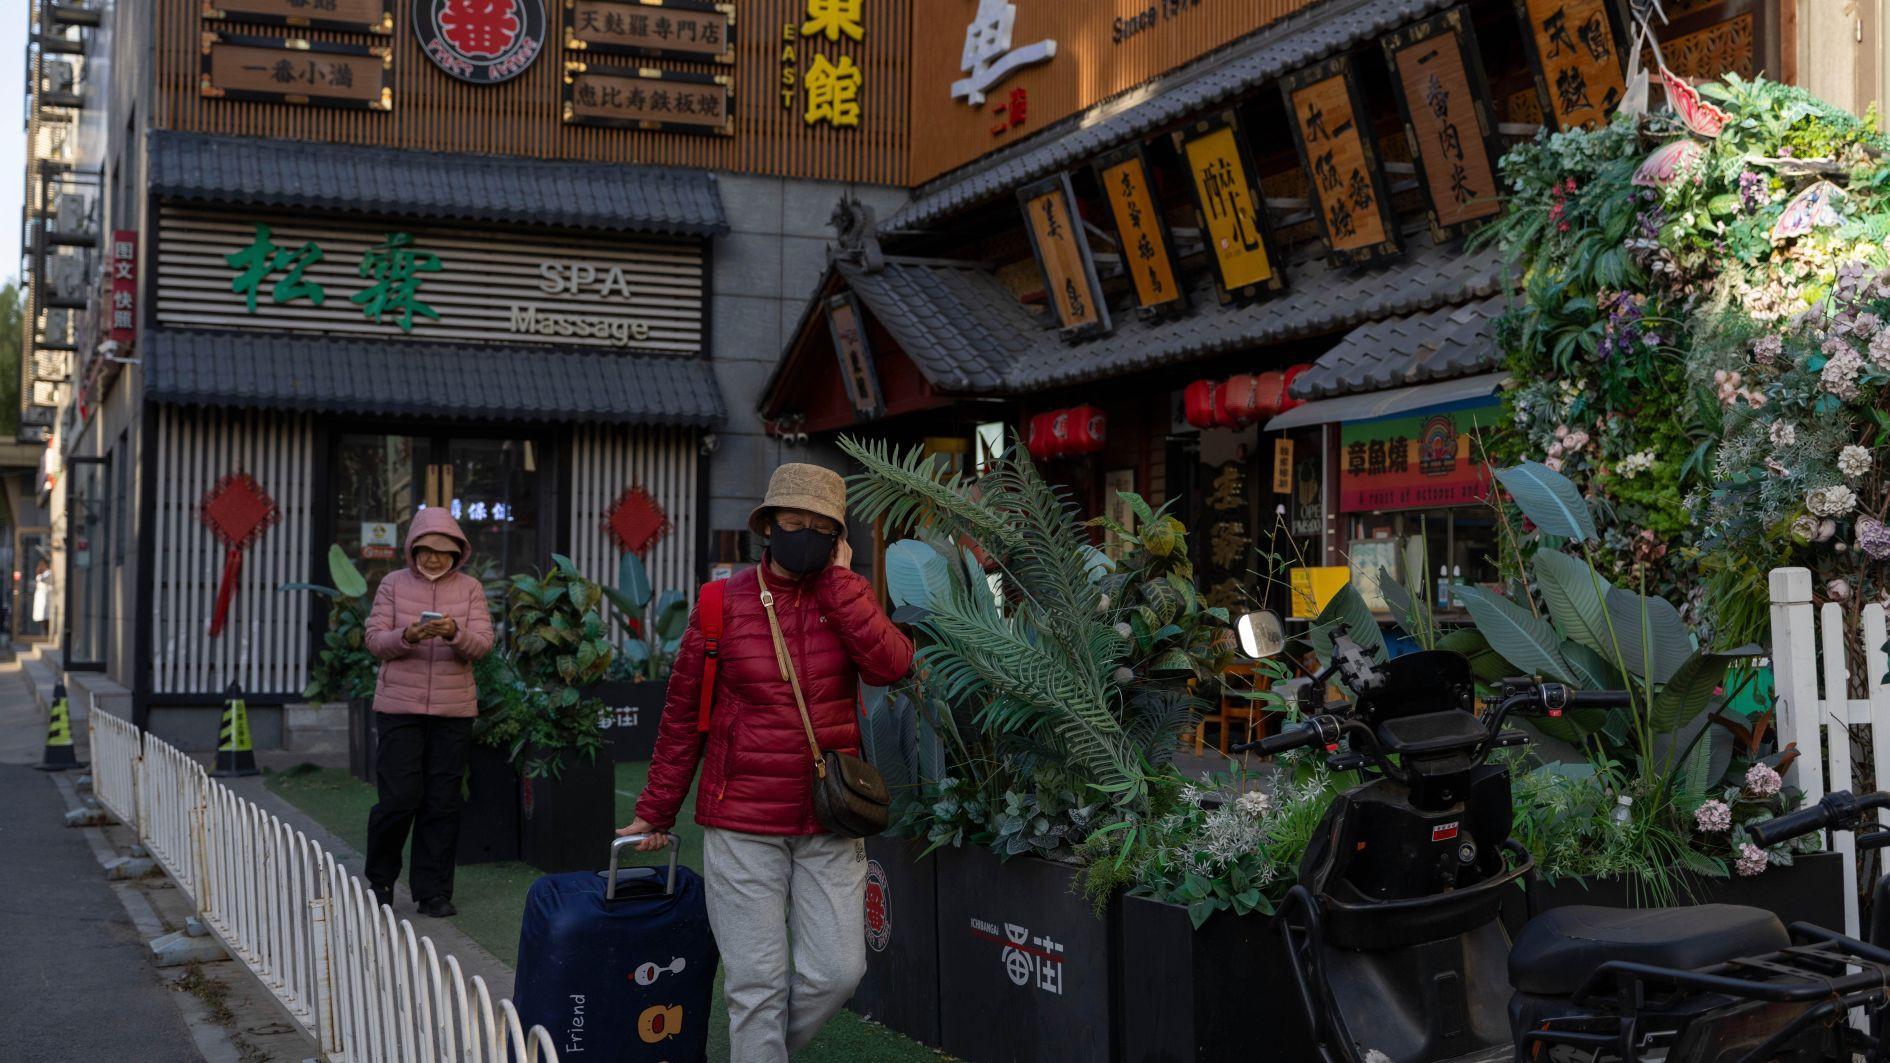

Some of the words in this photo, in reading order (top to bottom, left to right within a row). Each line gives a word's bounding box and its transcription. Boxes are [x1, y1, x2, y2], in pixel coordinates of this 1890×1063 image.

[1112, 6, 1157, 46] Since
[782, 23, 797, 108] EAST
[538, 261, 632, 299] SPA
[509, 306, 650, 346] Massage
[970, 918, 999, 936] ICHIBANGAI
[565, 994, 586, 1054] Friend
